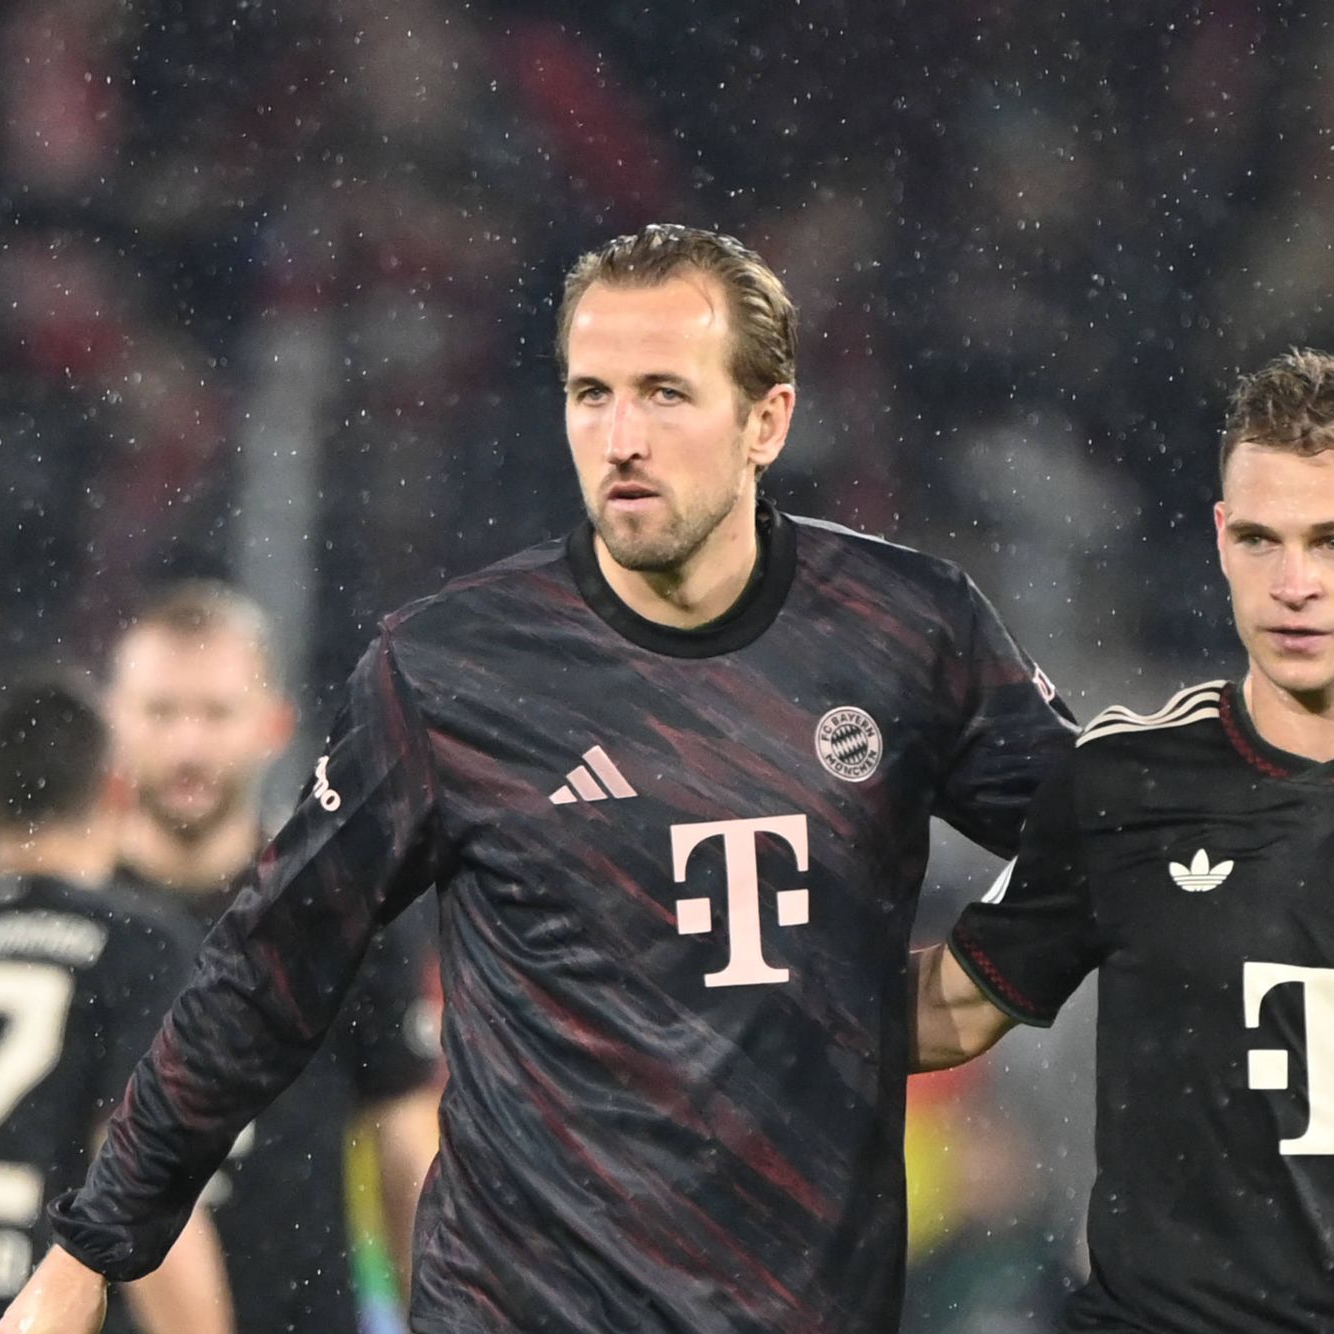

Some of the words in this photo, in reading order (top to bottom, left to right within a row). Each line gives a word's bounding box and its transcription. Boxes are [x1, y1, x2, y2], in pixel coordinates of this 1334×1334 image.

[821, 725, 832, 742] FC
[831, 713, 875, 738] BAYERN
[670, 814, 809, 987] T
